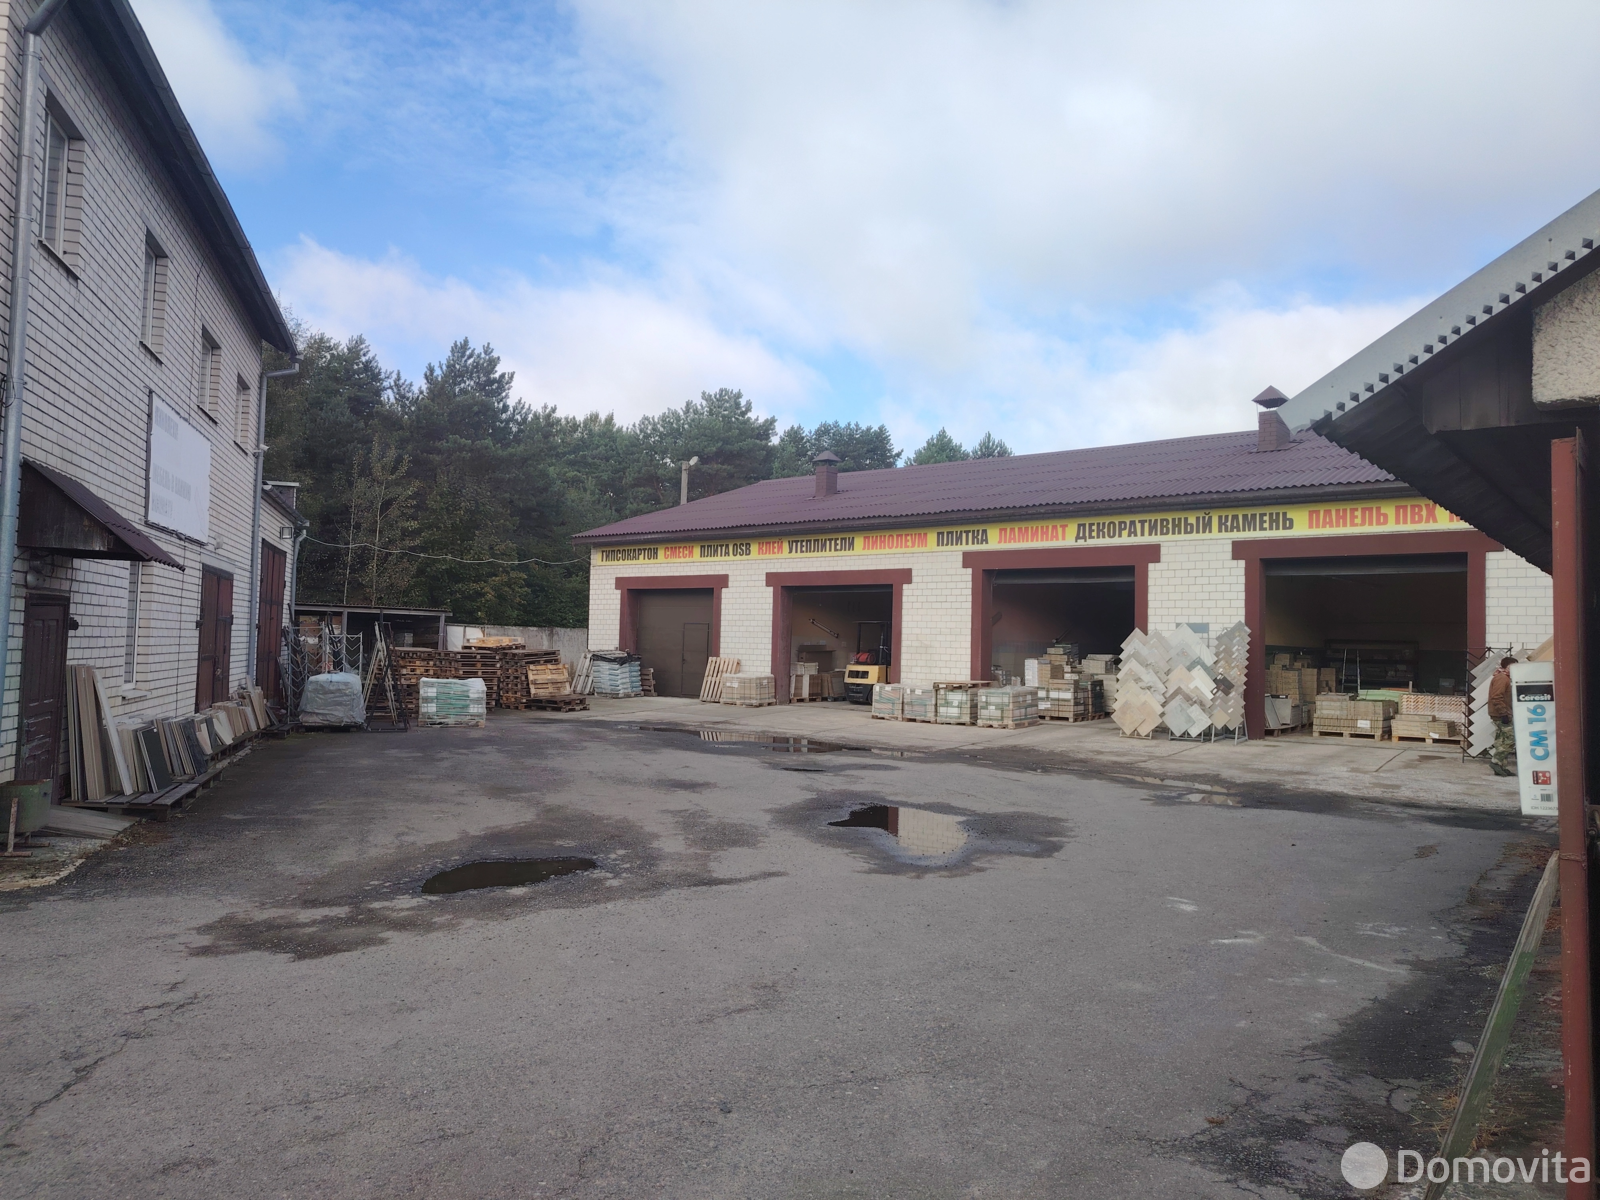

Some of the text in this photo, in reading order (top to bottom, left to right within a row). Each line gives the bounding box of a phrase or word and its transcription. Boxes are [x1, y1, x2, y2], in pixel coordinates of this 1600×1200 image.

[601, 546, 659, 562] ГИПСОКАРТОН
[663, 545, 695, 560] СМЕСИ
[699, 543, 730, 558] ПЛИТА
[732, 542, 752, 557] OSB
[757, 538, 784, 556] КЛЕЙ
[787, 536, 855, 554] УТЕПЛИТЕЛИ
[862, 532, 928, 551] ЛИНОЛЕУМ
[936, 528, 989, 547] ПЛИТКА
[997, 524, 1069, 544] ЛАМИНАТ
[1074, 511, 1213, 543] ДЕКОРАТИВНЫЙ
[1217, 511, 1295, 533] КАМЕНЬ
[1308, 506, 1389, 529] ПАНЕЛЬ
[1394, 503, 1439, 526] ПВХ
[1527, 704, 1550, 761] CM 16
